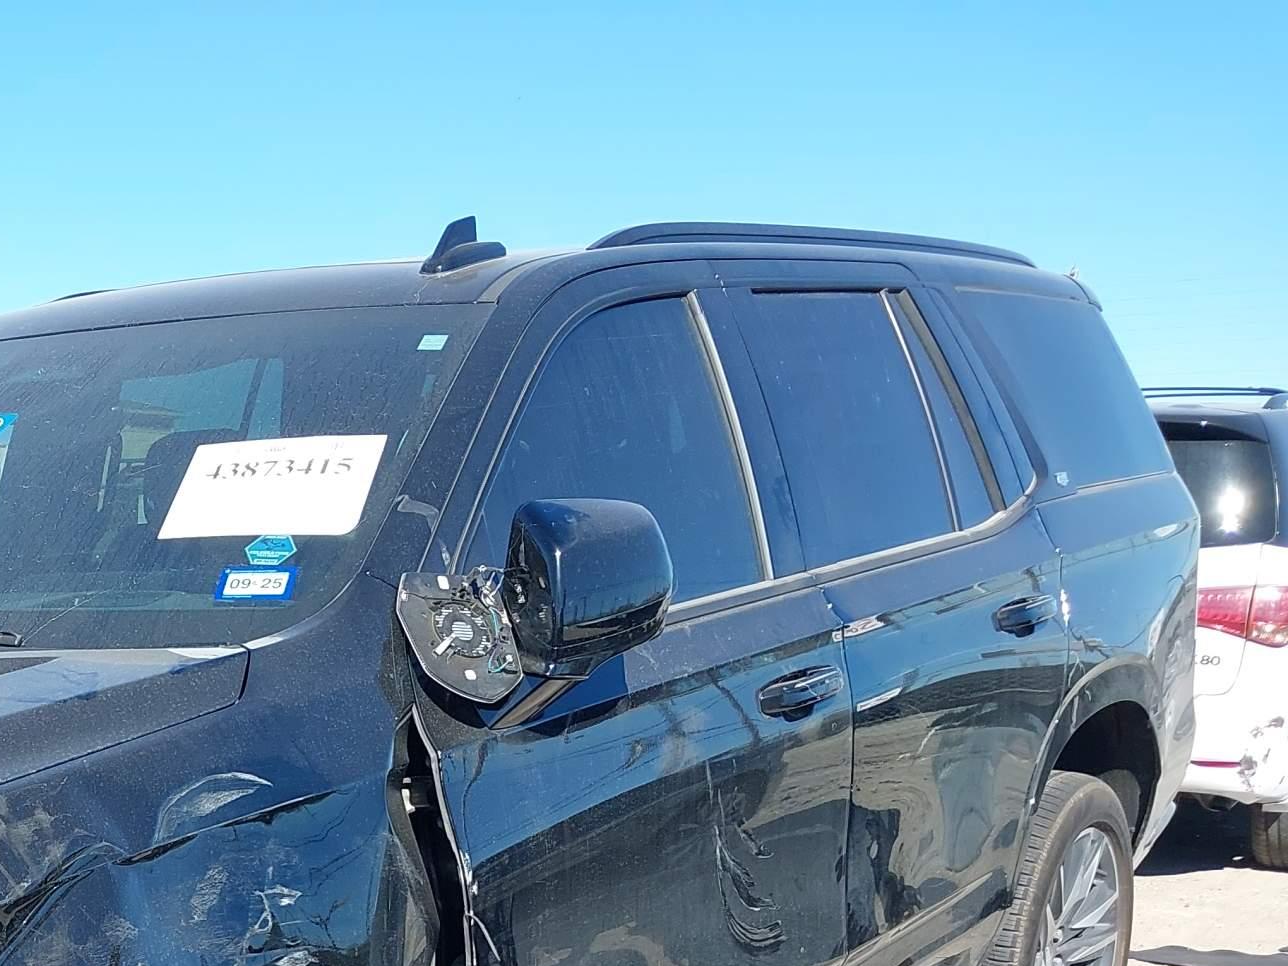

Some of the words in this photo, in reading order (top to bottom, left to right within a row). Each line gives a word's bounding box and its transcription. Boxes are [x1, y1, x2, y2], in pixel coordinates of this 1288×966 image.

[206, 457, 353, 480] 43873415
[229, 577, 251, 589] 09
[259, 577, 283, 589] 25
[1194, 655, 1221, 667] 80
